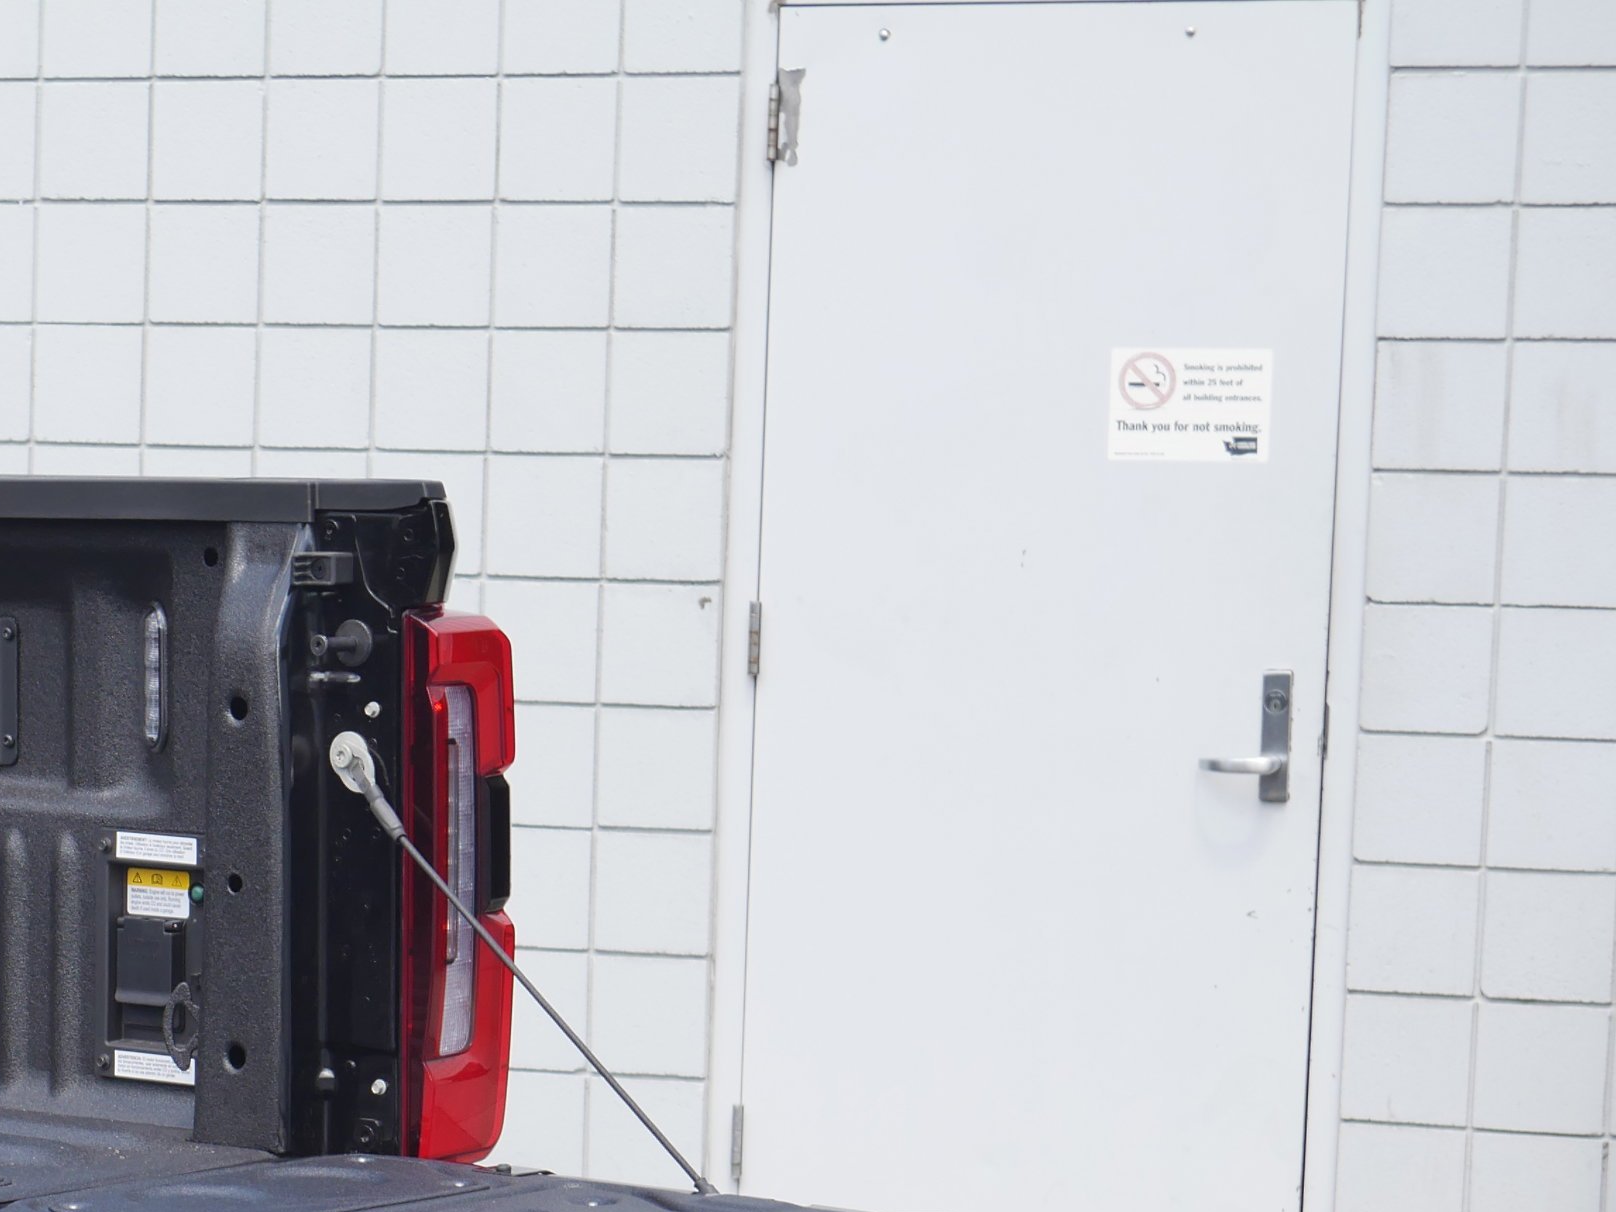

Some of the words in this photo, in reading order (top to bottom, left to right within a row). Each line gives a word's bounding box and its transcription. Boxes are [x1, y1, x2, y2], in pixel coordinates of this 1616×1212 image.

[1184, 363, 1215, 372] Smoking
[1225, 363, 1263, 372] prohibited
[1183, 378, 1205, 386] within
[1219, 378, 1233, 386] feet
[1235, 378, 1243, 386] of
[1183, 393, 1191, 401] all
[1193, 393, 1223, 402] building
[1116, 419, 1148, 431] Thank
[1151, 422, 1171, 434] you
[1173, 420, 1189, 432] for
[1193, 421, 1210, 432] not
[1213, 421, 1262, 435] smoking.
